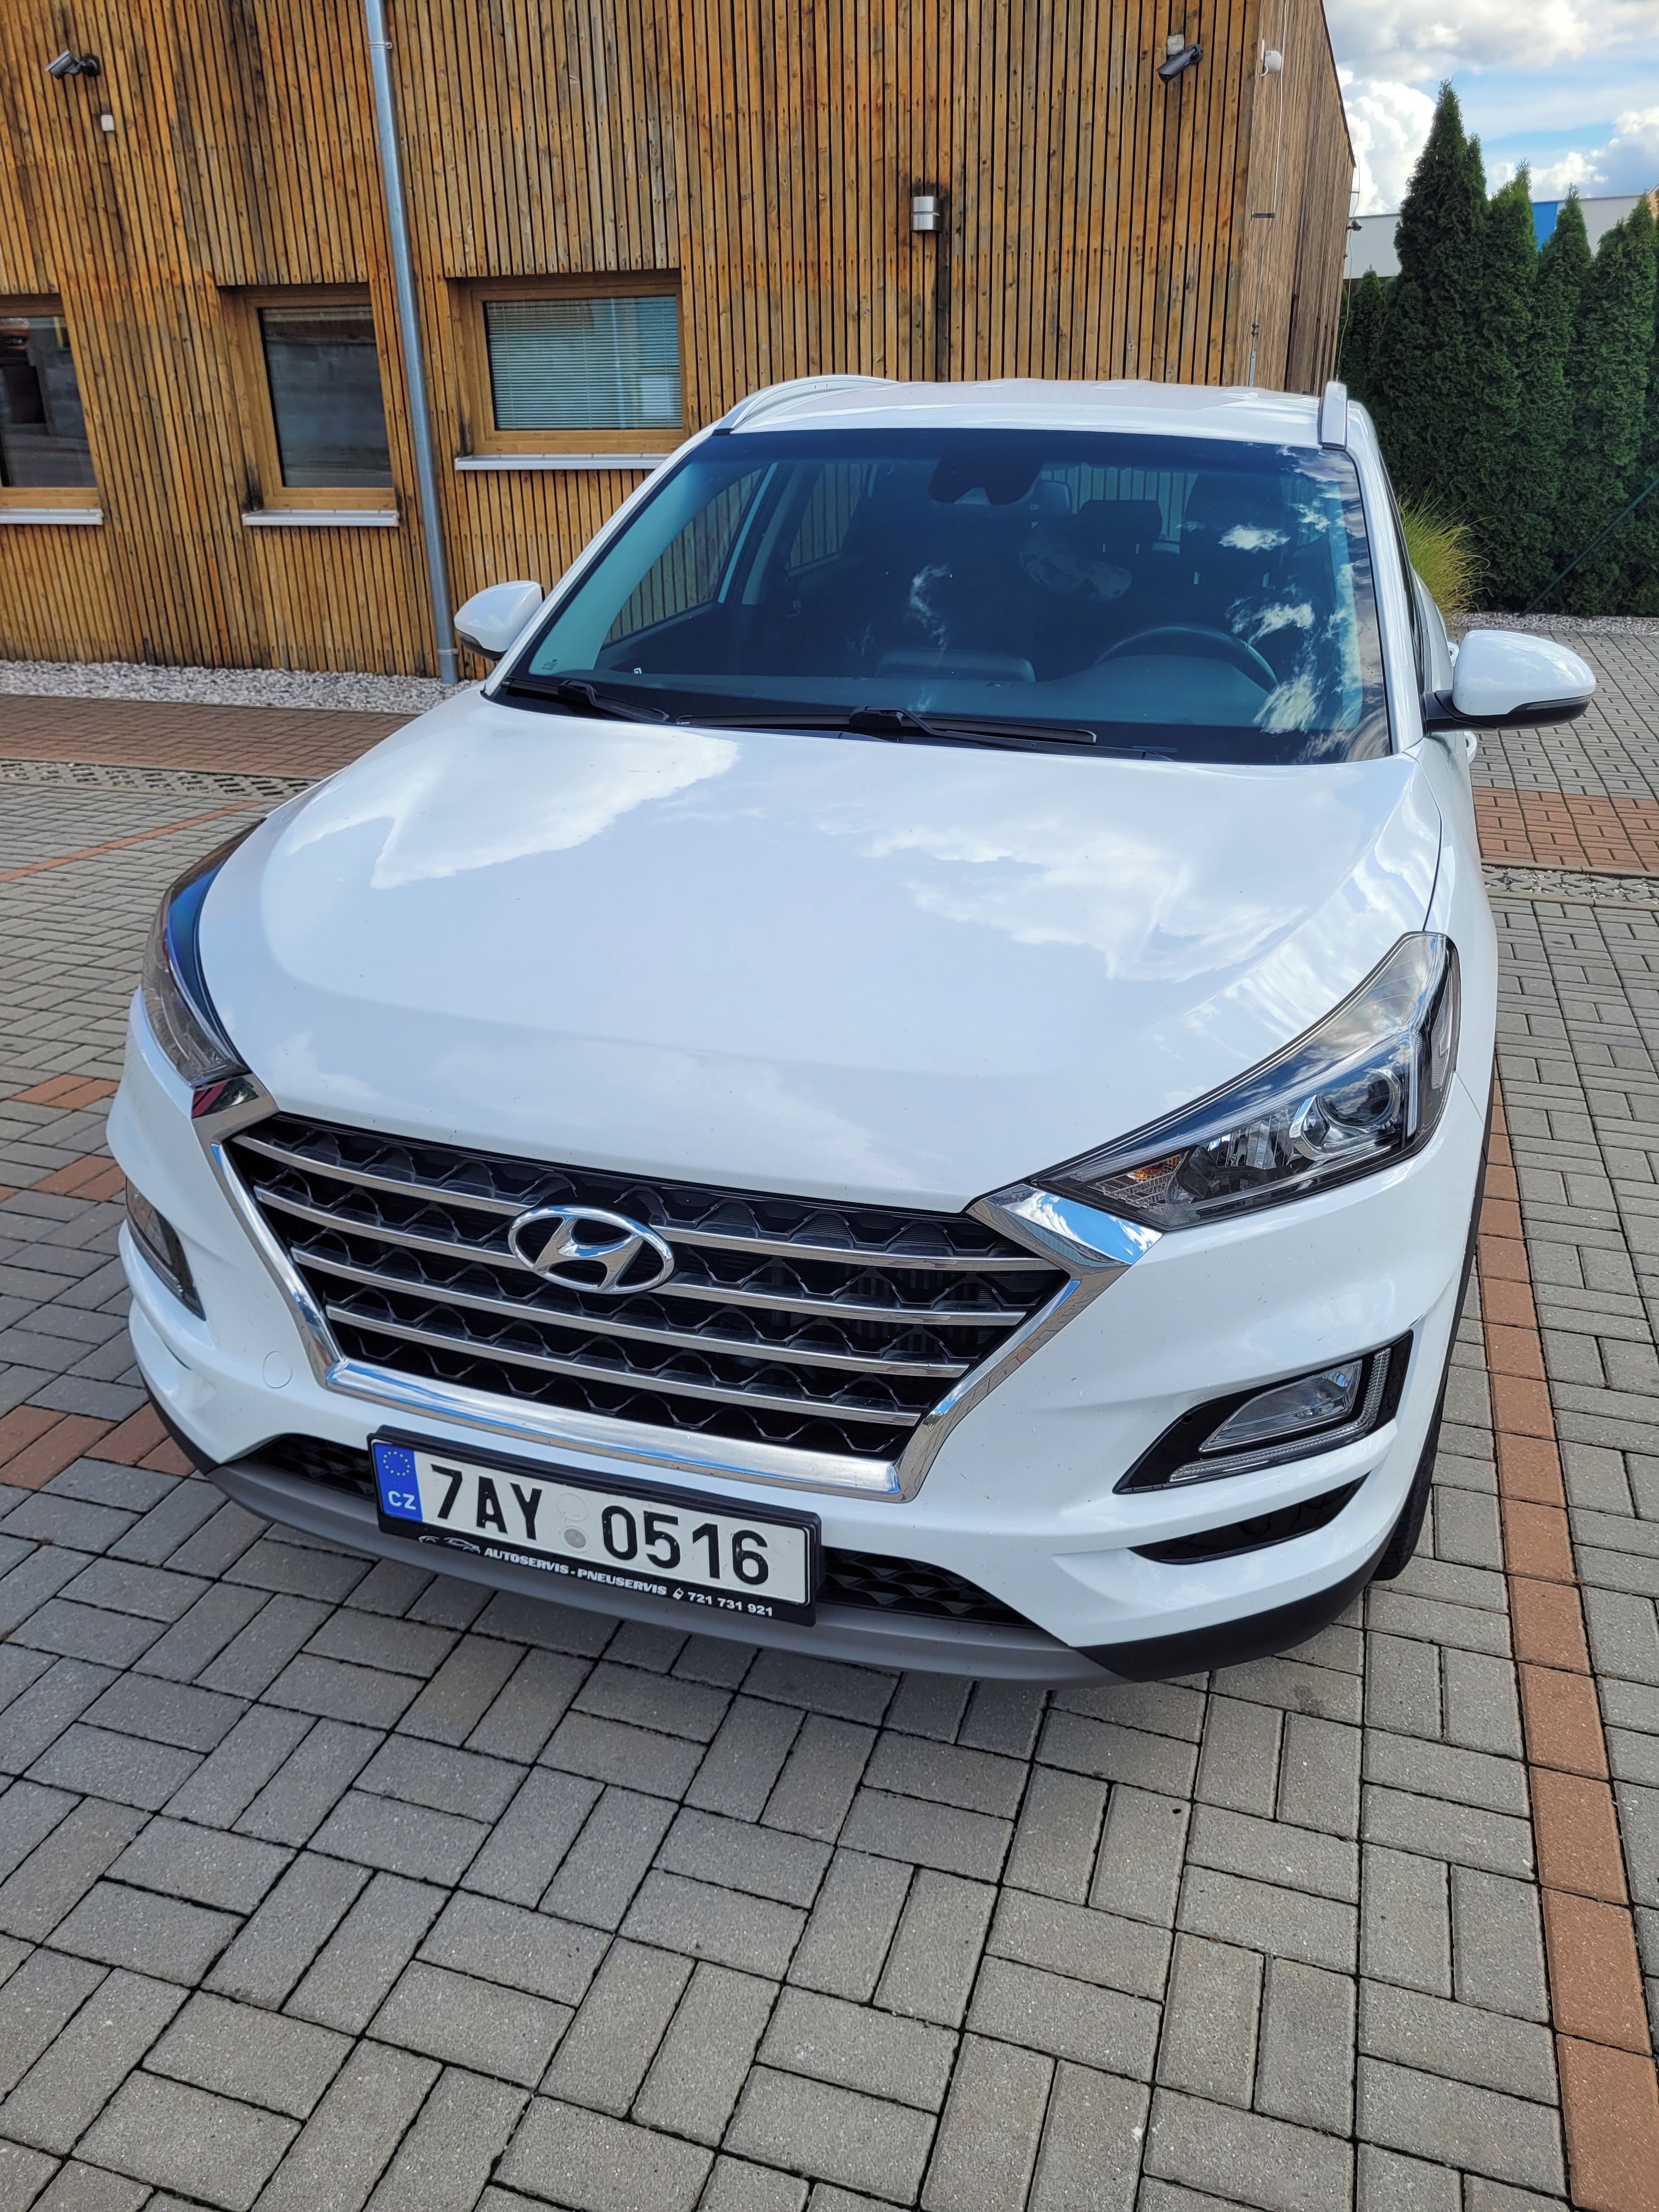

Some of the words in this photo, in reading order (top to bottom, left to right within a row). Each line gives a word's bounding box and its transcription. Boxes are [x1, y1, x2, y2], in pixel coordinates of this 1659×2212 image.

[388, 1491, 416, 1510] CZ
[431, 1463, 543, 1541] 7AY
[601, 1505, 769, 1585] 0516
[484, 1547, 569, 1575] AUTOSERVIS
[577, 1568, 668, 1596] PNEUSERVIS
[687, 1592, 713, 1605] 721
[717, 1597, 742, 1611] 731
[747, 1602, 773, 1617] 921
